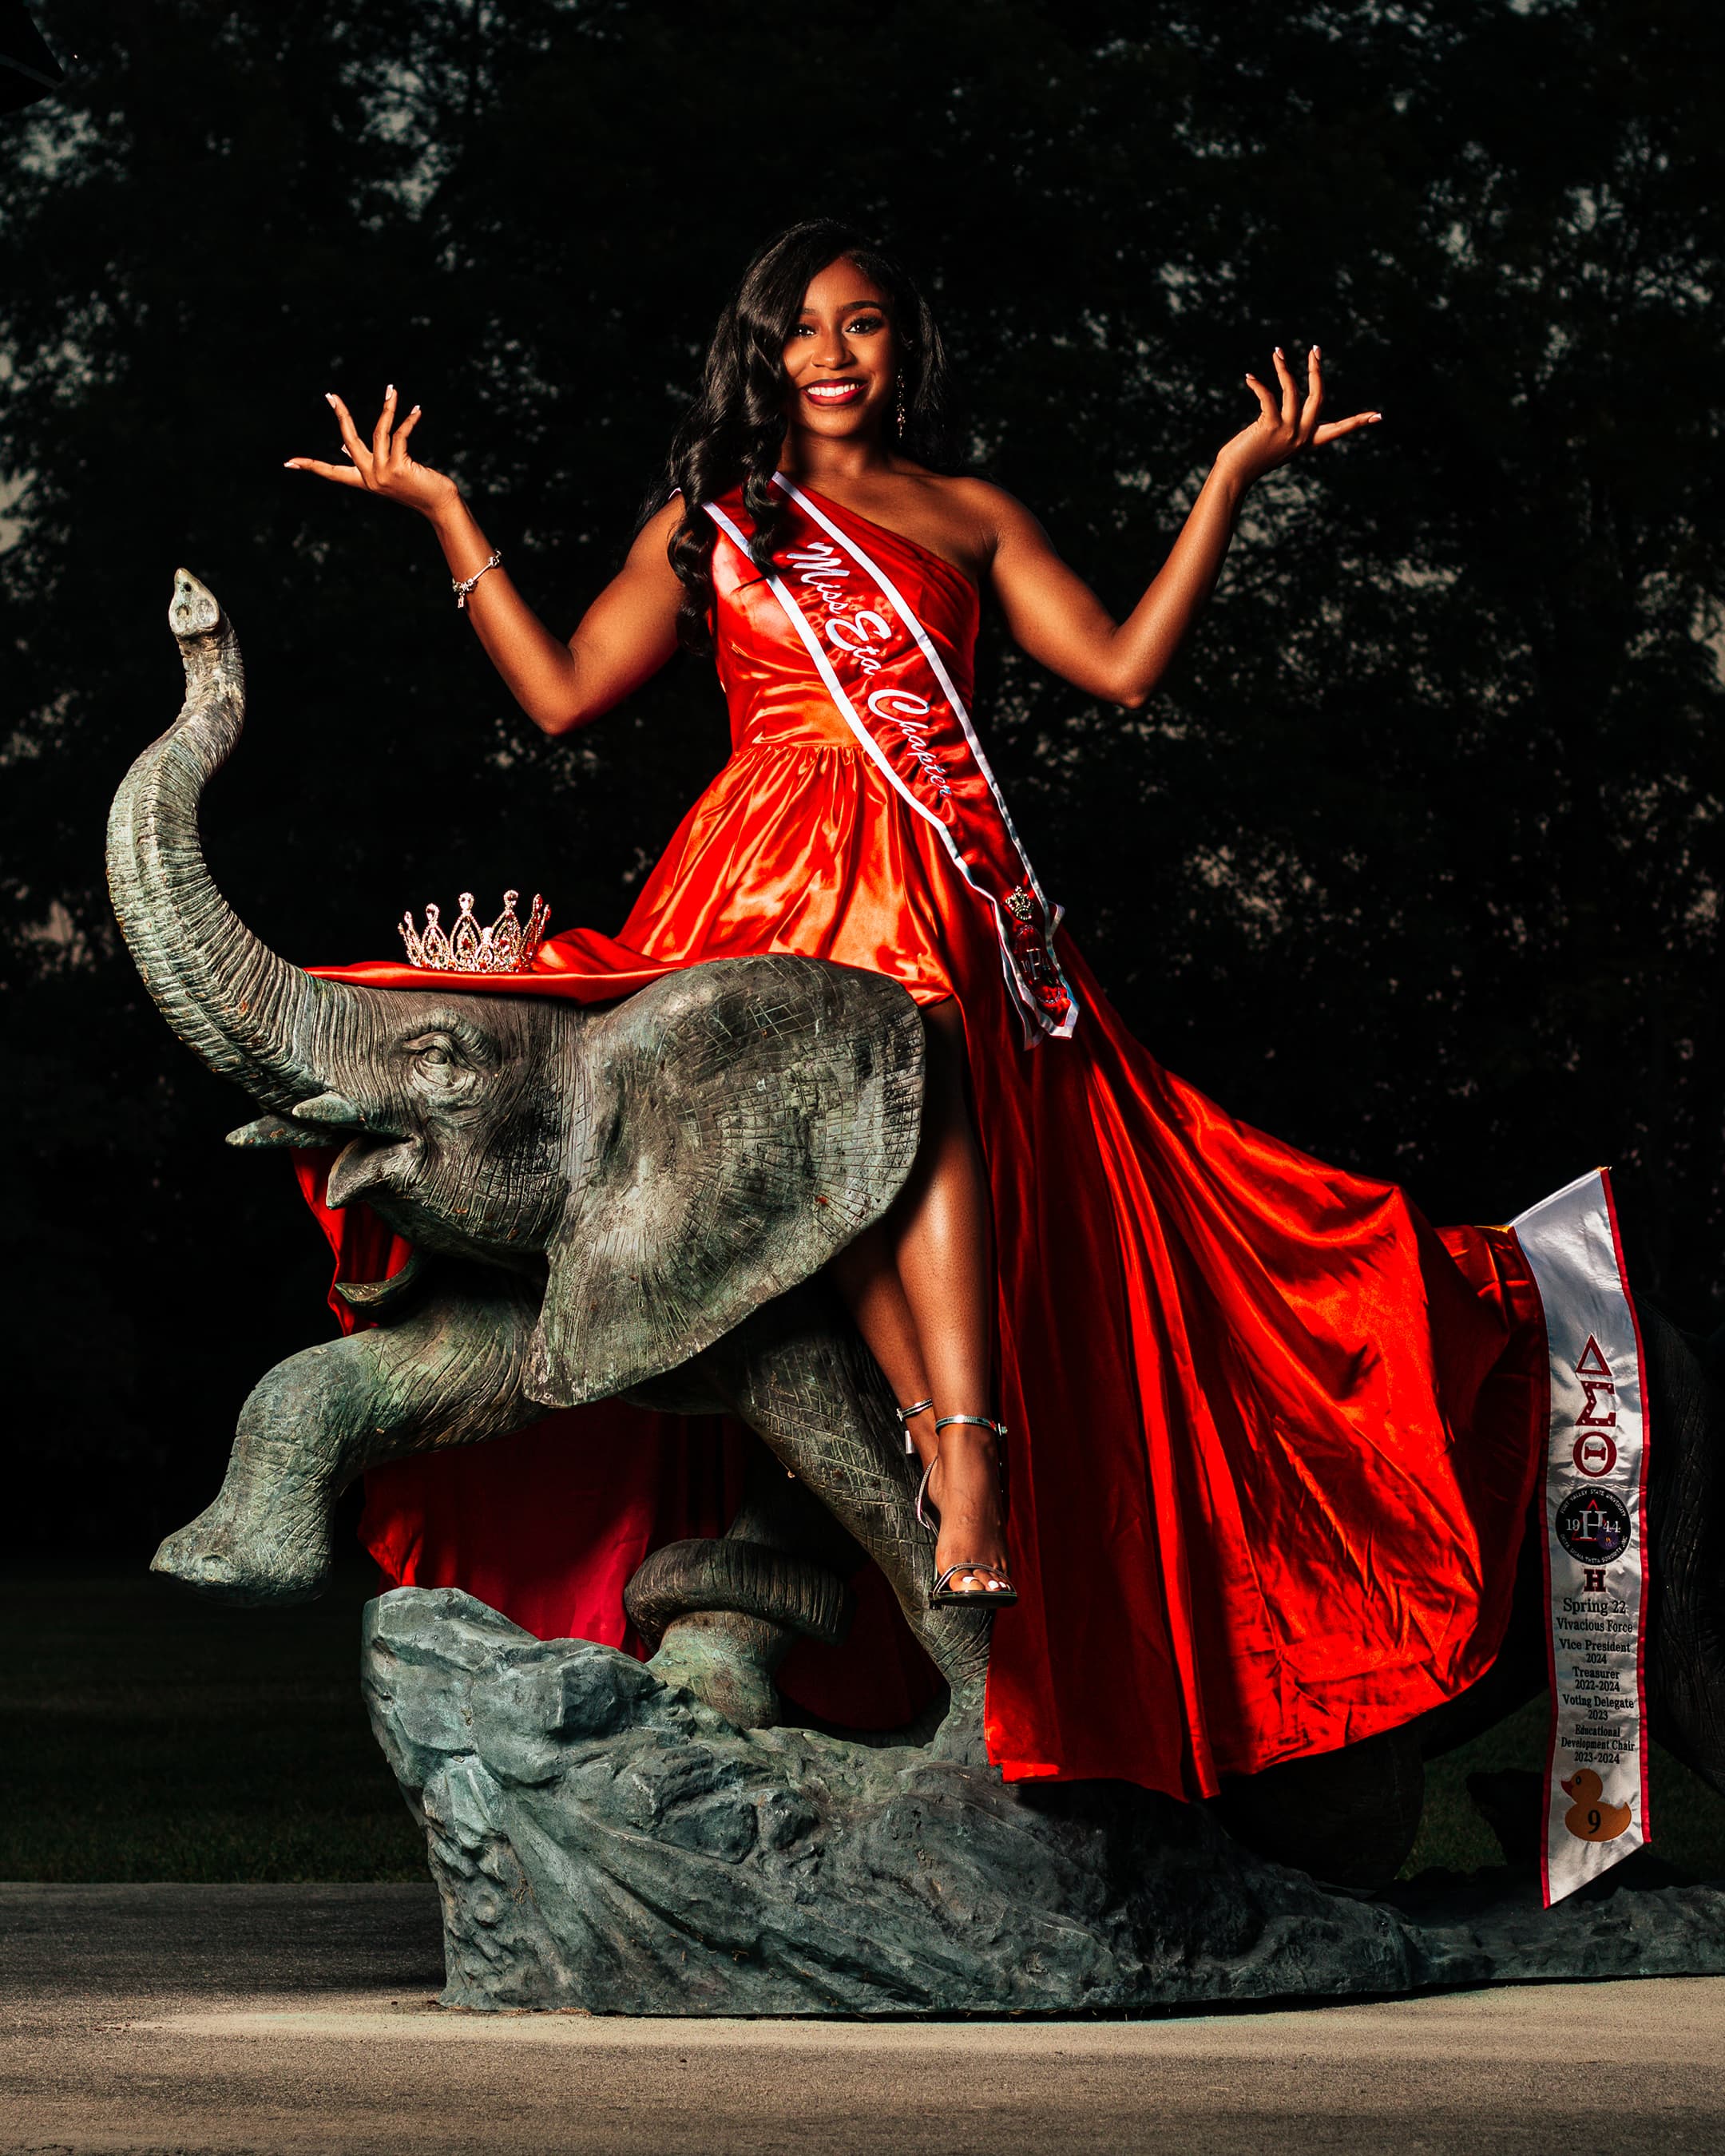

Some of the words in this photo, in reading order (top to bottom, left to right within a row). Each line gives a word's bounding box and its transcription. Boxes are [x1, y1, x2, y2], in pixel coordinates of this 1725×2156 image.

[787, 542, 850, 615] Miss
[824, 610, 892, 676] Eta
[867, 688, 953, 798] Chapter
[1571, 1490, 1588, 1502] VALLEY
[1563, 1597, 1608, 1616] Spring
[1612, 1600, 1626, 1614] 22
[1556, 1618, 1604, 1631] Vivacious
[1608, 1619, 1633, 1632] Force
[1559, 1639, 1582, 1650] Vice
[1584, 1639, 1630, 1652] President
[1586, 1654, 1607, 1664] 2024
[1572, 1667, 1620, 1679] Treasurer
[1575, 1679, 1620, 1692] 2022-2024
[1563, 1694, 1592, 1708] Voting
[1595, 1696, 1634, 1710] Delegate
[1588, 1710, 1608, 1721] 2023
[1575, 1724, 1620, 1737] Educational
[1561, 1738, 1609, 1750] Development
[1612, 1740, 1635, 1751] Chair
[1574, 1751, 1620, 1764] 2023-2024
[1588, 1809, 1601, 1834] 9
